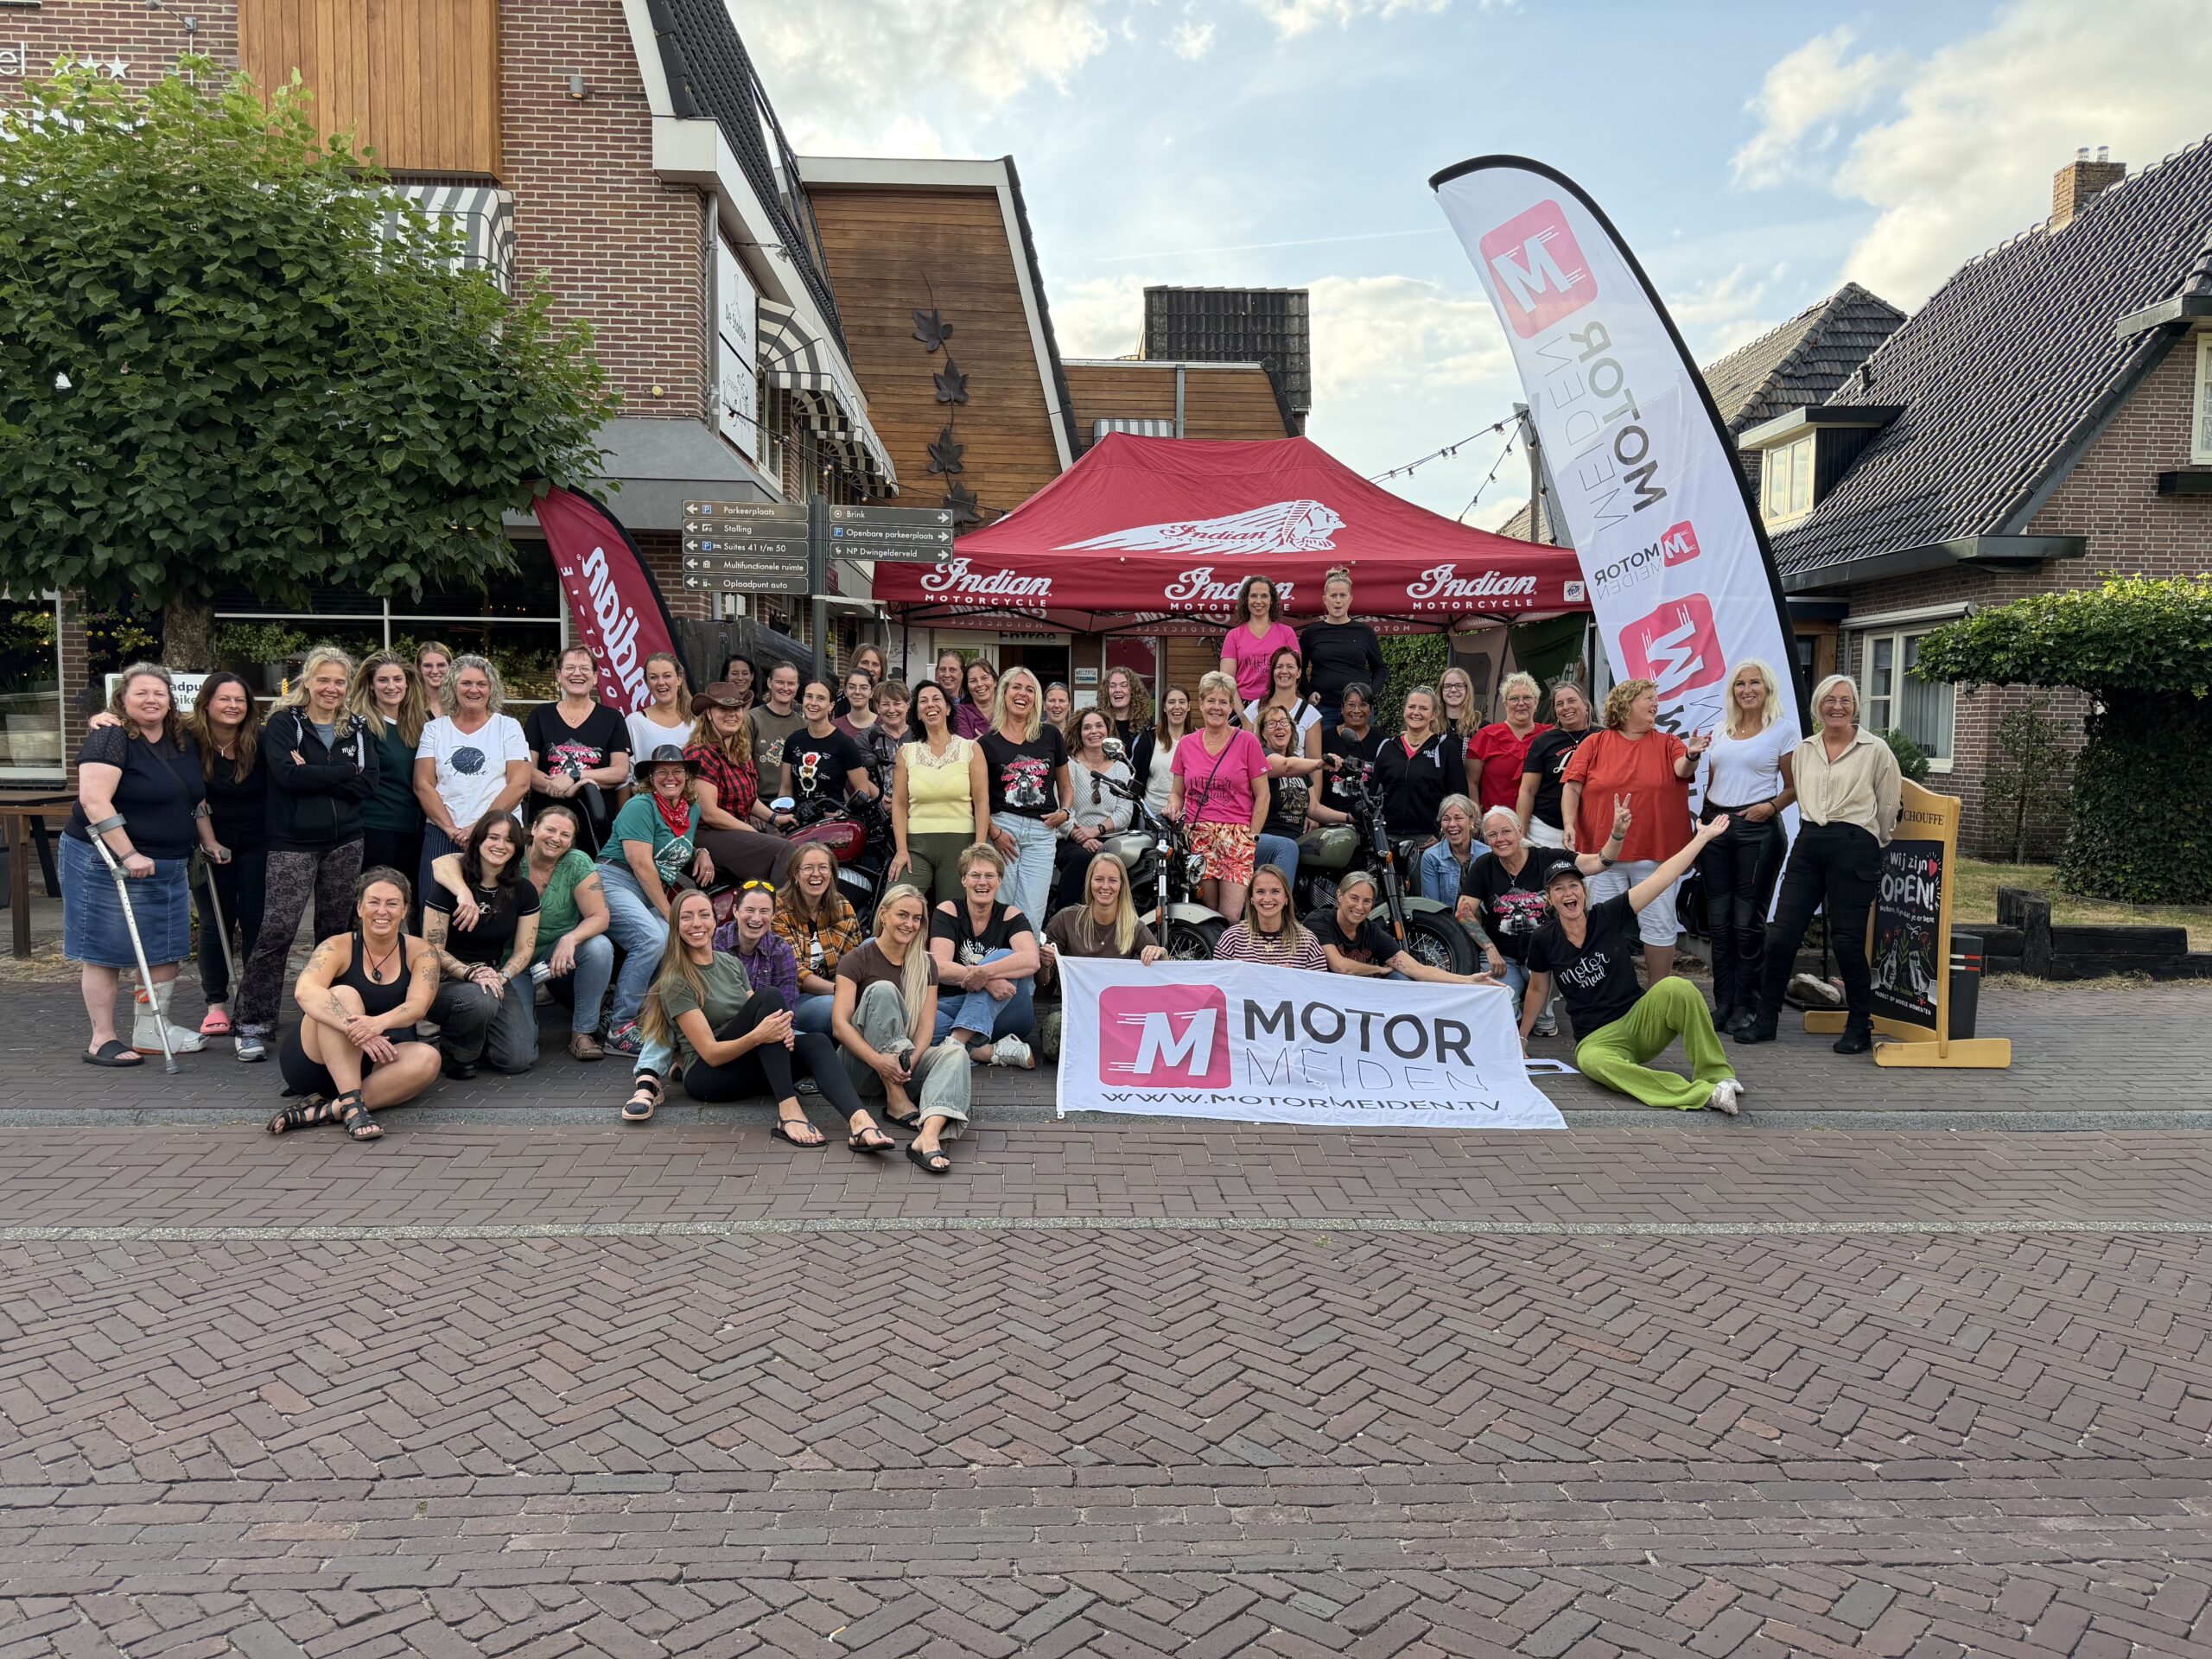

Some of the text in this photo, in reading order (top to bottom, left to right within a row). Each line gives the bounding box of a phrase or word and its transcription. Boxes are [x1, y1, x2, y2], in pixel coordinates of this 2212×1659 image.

[723, 506, 775, 516] Parkeerplaats
[846, 510, 865, 518] Brink
[723, 524, 753, 535] Stalling
[846, 530, 884, 540] Openbare
[885, 531, 934, 541] parkeerplaats
[1159, 524, 1267, 539] Indian
[723, 543, 746, 552] Suites
[760, 543, 774, 554] t/m
[860, 548, 918, 558] Dwingelderveld
[723, 561, 804, 573] Multifunctionele ruimte
[920, 557, 1052, 597] Indian
[1164, 567, 1295, 601] Indn
[1406, 563, 1537, 600] Indian
[723, 580, 788, 590] Oplaadpunt auto
[925, 594, 1047, 607] MOTORCYCLE
[1170, 603, 1290, 612] MOTORE
[1412, 599, 1534, 610] MOTORCYCLE
[1903, 810, 1944, 826] CHOUFFE
[1890, 851, 1928, 874] Wij zijn
[1880, 873, 1935, 912] OPEN!
[1910, 912, 1916, 922] je
[1923, 915, 1935, 924] bent
[1559, 951, 1611, 985] Motor
[1579, 965, 1607, 988] Meid
[1909, 1002, 1932, 1016] MOMENTEN
[1243, 998, 1476, 1067] MOTOR
[1246, 1047, 1490, 1091] MEIDEN
[1101, 1092, 1501, 1112] WWW.MOTORMEIDEN.TV
